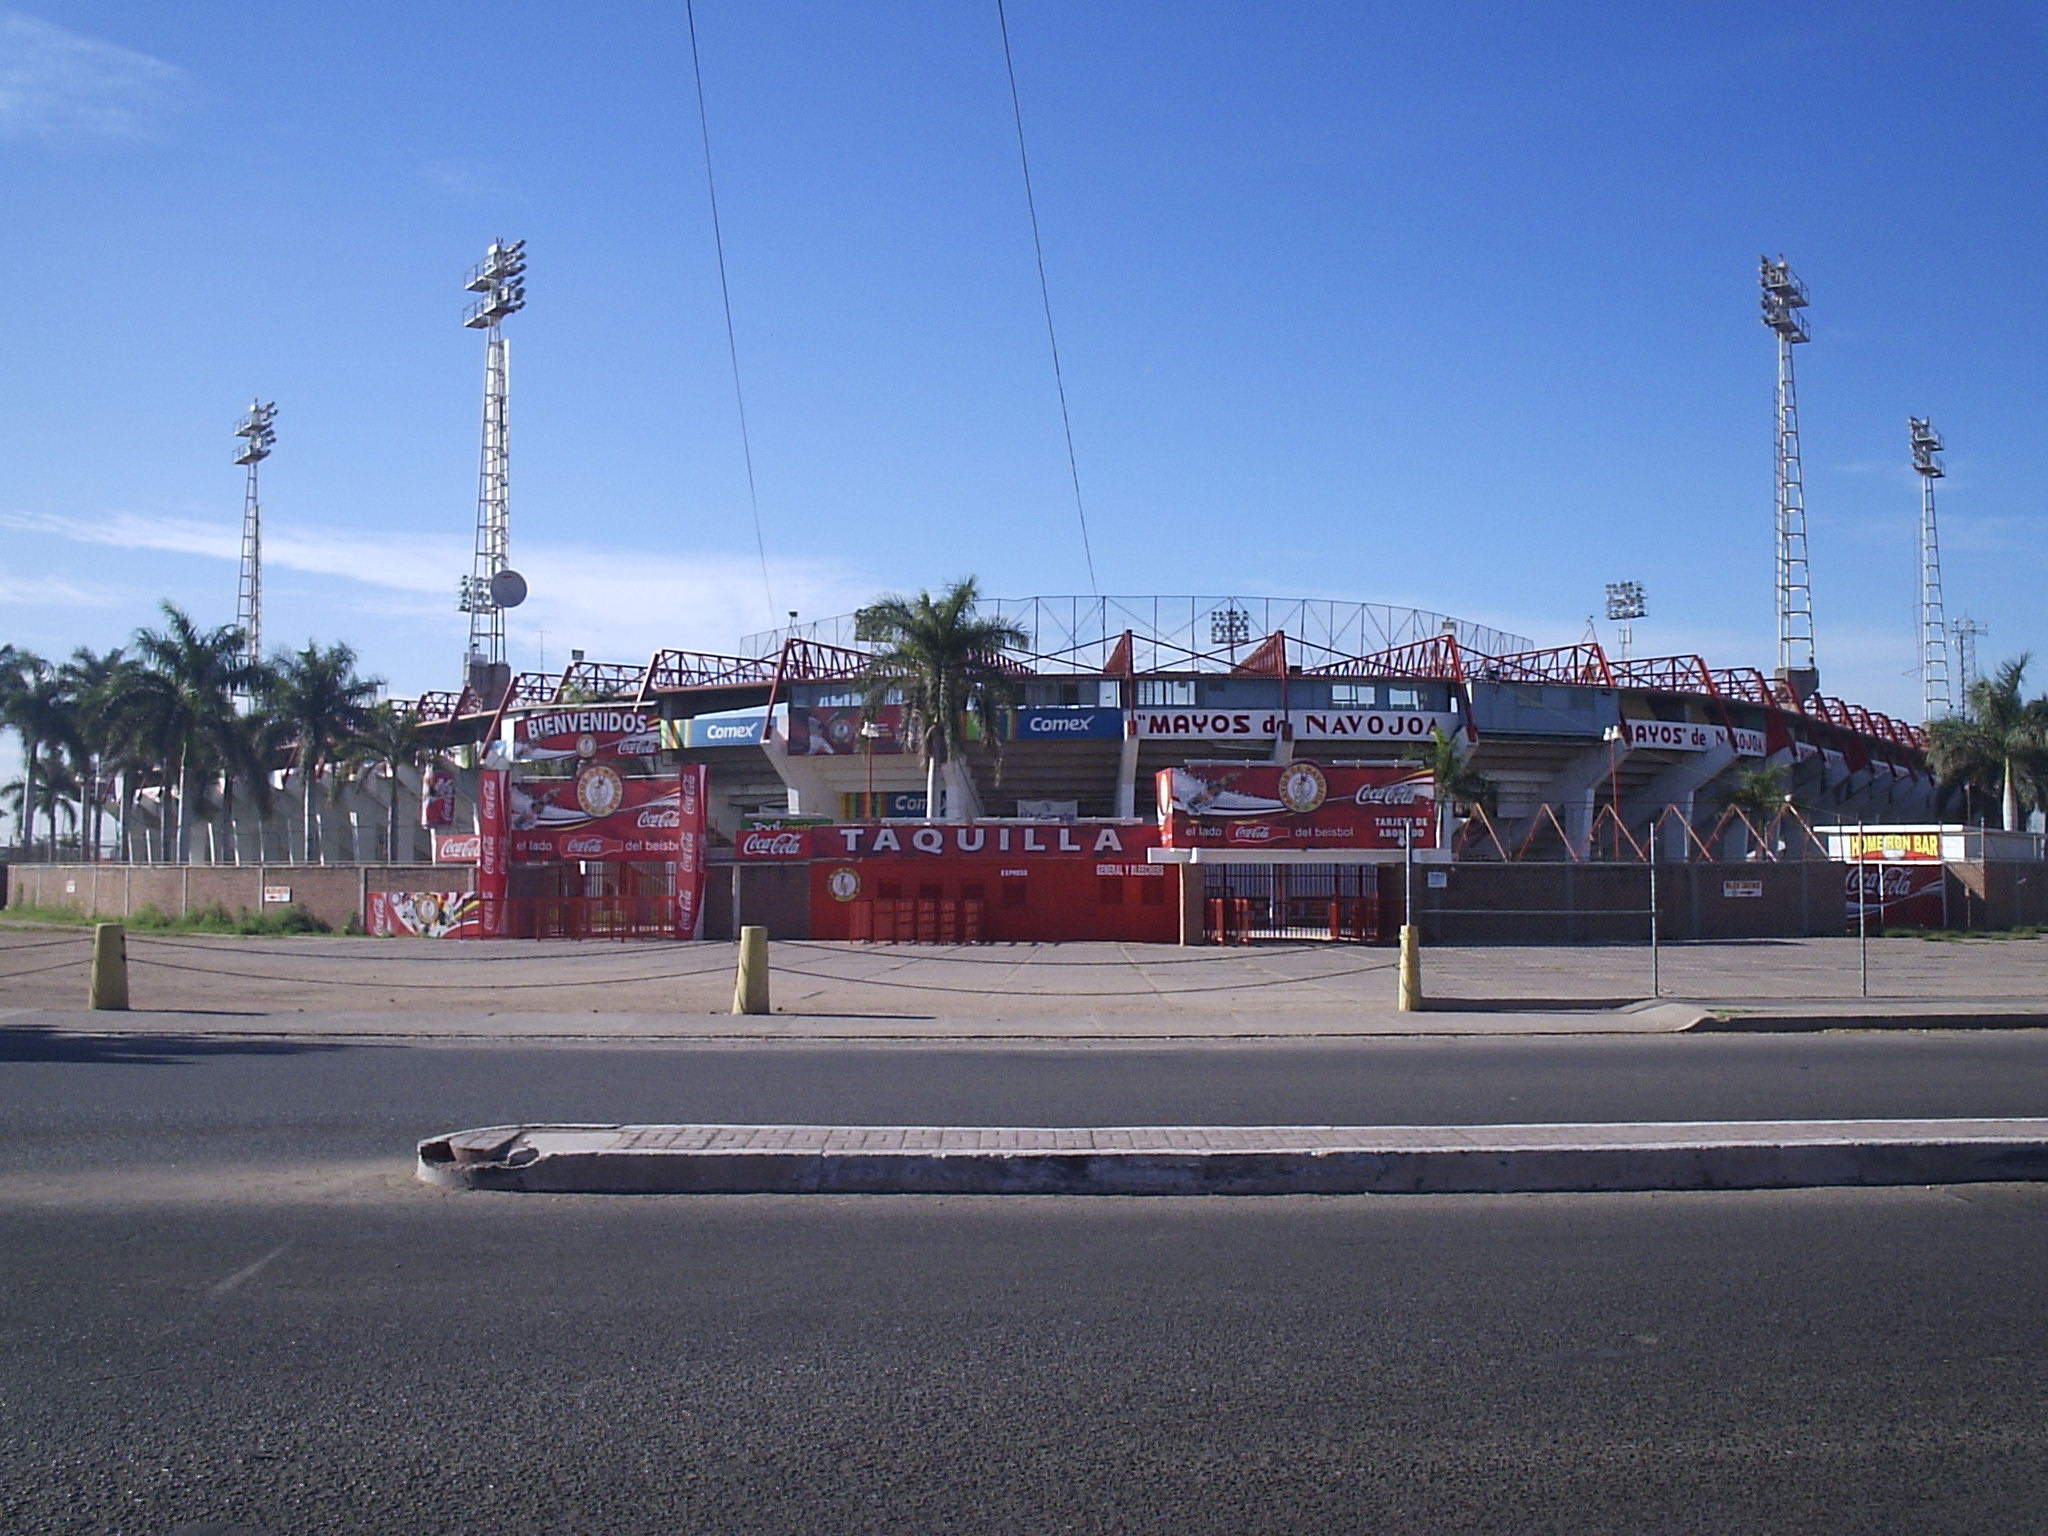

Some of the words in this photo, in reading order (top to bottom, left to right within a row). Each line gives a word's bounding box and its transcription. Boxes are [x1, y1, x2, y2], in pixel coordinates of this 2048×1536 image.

[527, 712, 647, 739] BIENVENIDOS
[706, 722, 758, 740] Comex
[1029, 715, 1096, 732] Comex
[1295, 827, 1312, 837] del
[1315, 827, 1354, 837] beisbol
[1379, 829, 1425, 838] ABONDO
[840, 828, 1123, 855] TAQUILLA
[1914, 834, 1938, 857] BAR
